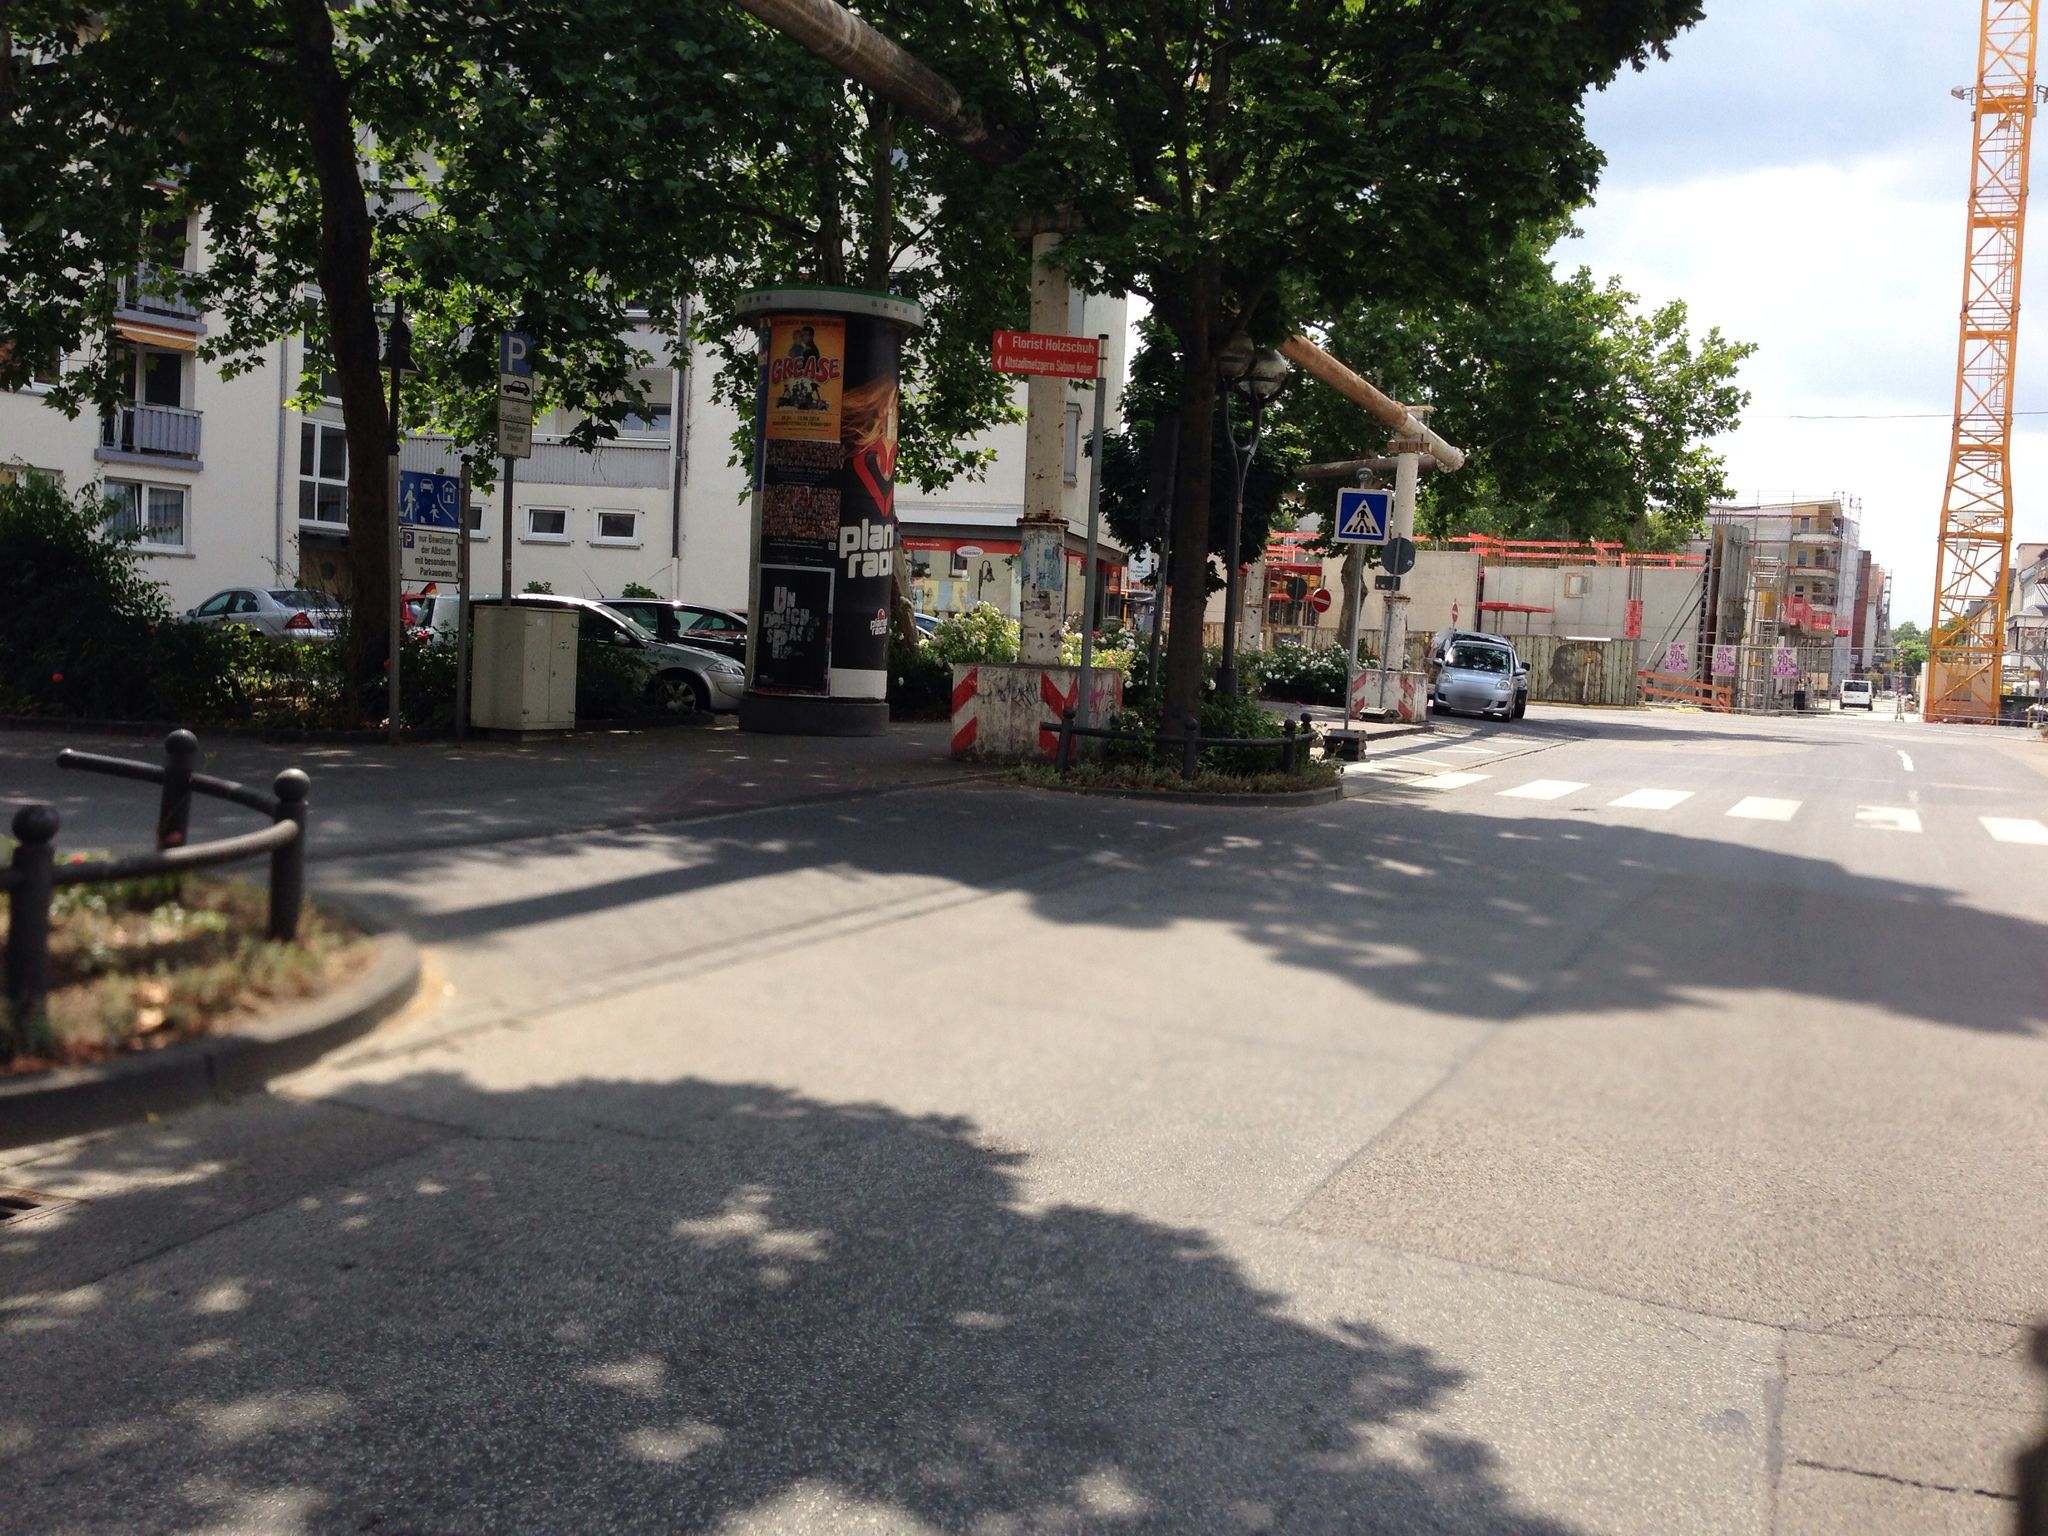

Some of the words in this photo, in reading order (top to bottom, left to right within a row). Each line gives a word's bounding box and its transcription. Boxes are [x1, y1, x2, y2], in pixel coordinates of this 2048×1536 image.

[508, 336, 527, 372] P
[1012, 335, 1044, 351] Florist
[1045, 338, 1095, 354] Holzschuh
[771, 356, 841, 384] GREASE
[1056, 359, 1076, 373] Sabine
[429, 534, 454, 544] Bewohner
[839, 518, 894, 558] plan
[431, 546, 451, 555] Altstadt
